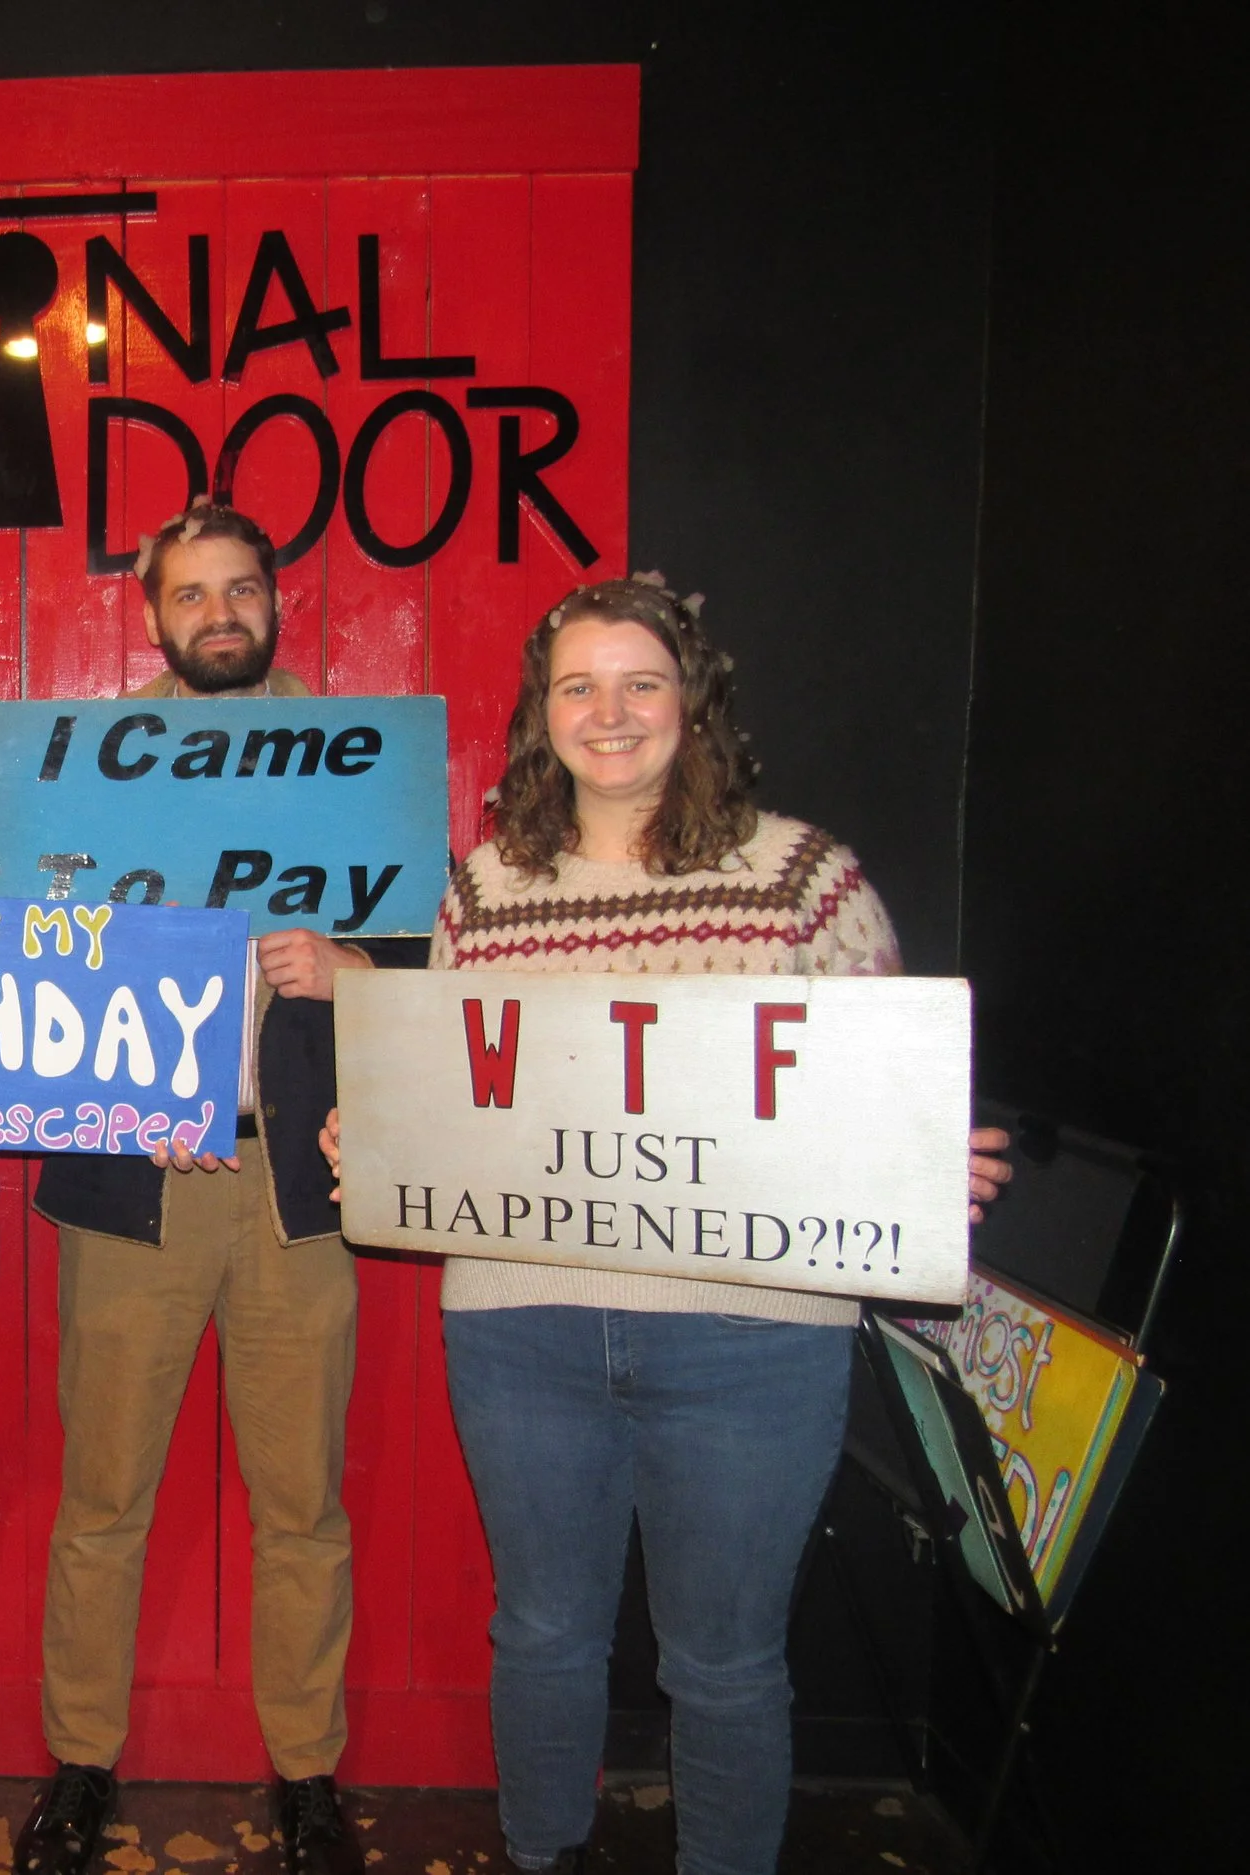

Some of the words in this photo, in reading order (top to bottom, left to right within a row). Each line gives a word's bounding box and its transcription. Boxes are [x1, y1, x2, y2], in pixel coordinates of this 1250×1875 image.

[86, 388, 602, 576] DOOR
[38, 716, 77, 783] I
[97, 713, 383, 782] Came
[205, 849, 404, 933] Pay
[22, 903, 113, 971] MY
[545, 1128, 718, 1185] JUST
[394, 1184, 903, 1275] HAPPENED?!?!
